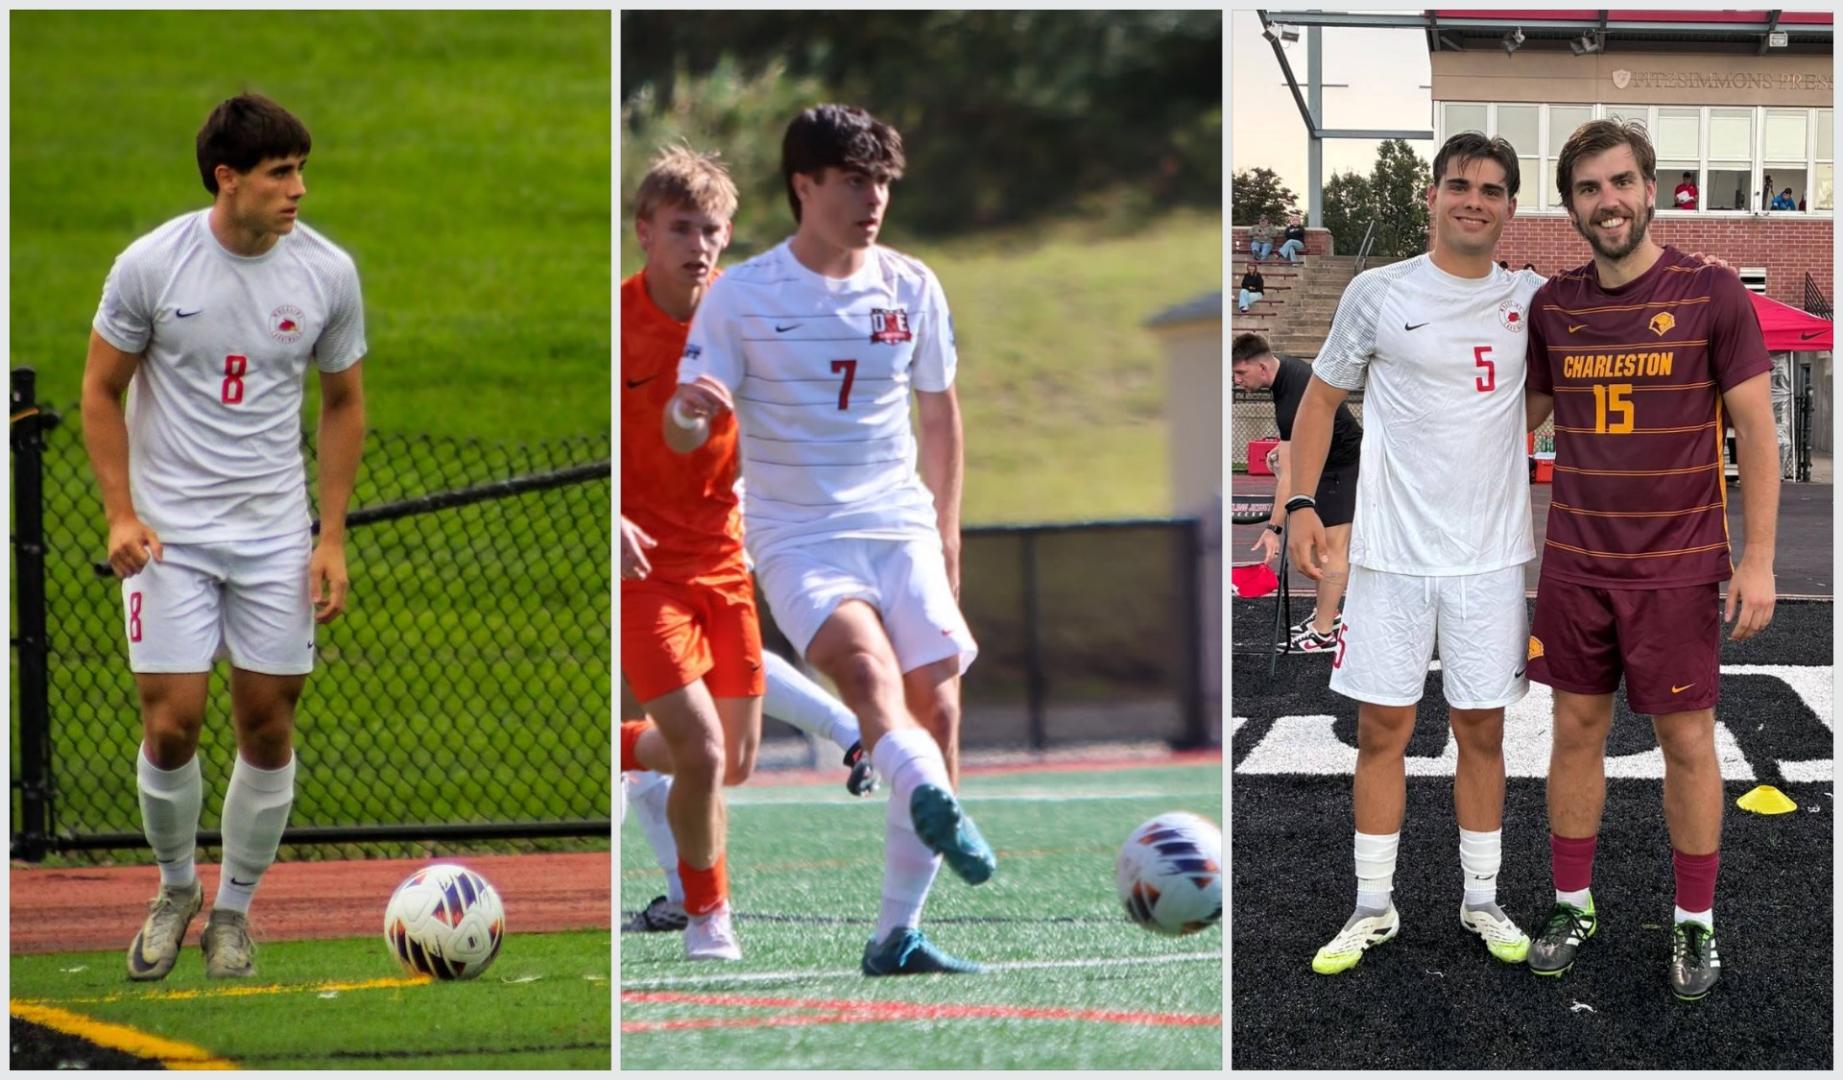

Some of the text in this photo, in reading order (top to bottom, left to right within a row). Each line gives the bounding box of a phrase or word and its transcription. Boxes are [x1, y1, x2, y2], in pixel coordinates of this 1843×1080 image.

[1631, 71, 1774, 90] FITZSIMMONS
[221, 353, 248, 406] 8
[830, 359, 857, 411] 7
[1473, 345, 1496, 393] 5
[1563, 351, 1675, 379] CHARLESTON
[1593, 383, 1635, 435] 15
[129, 591, 143, 643] 8
